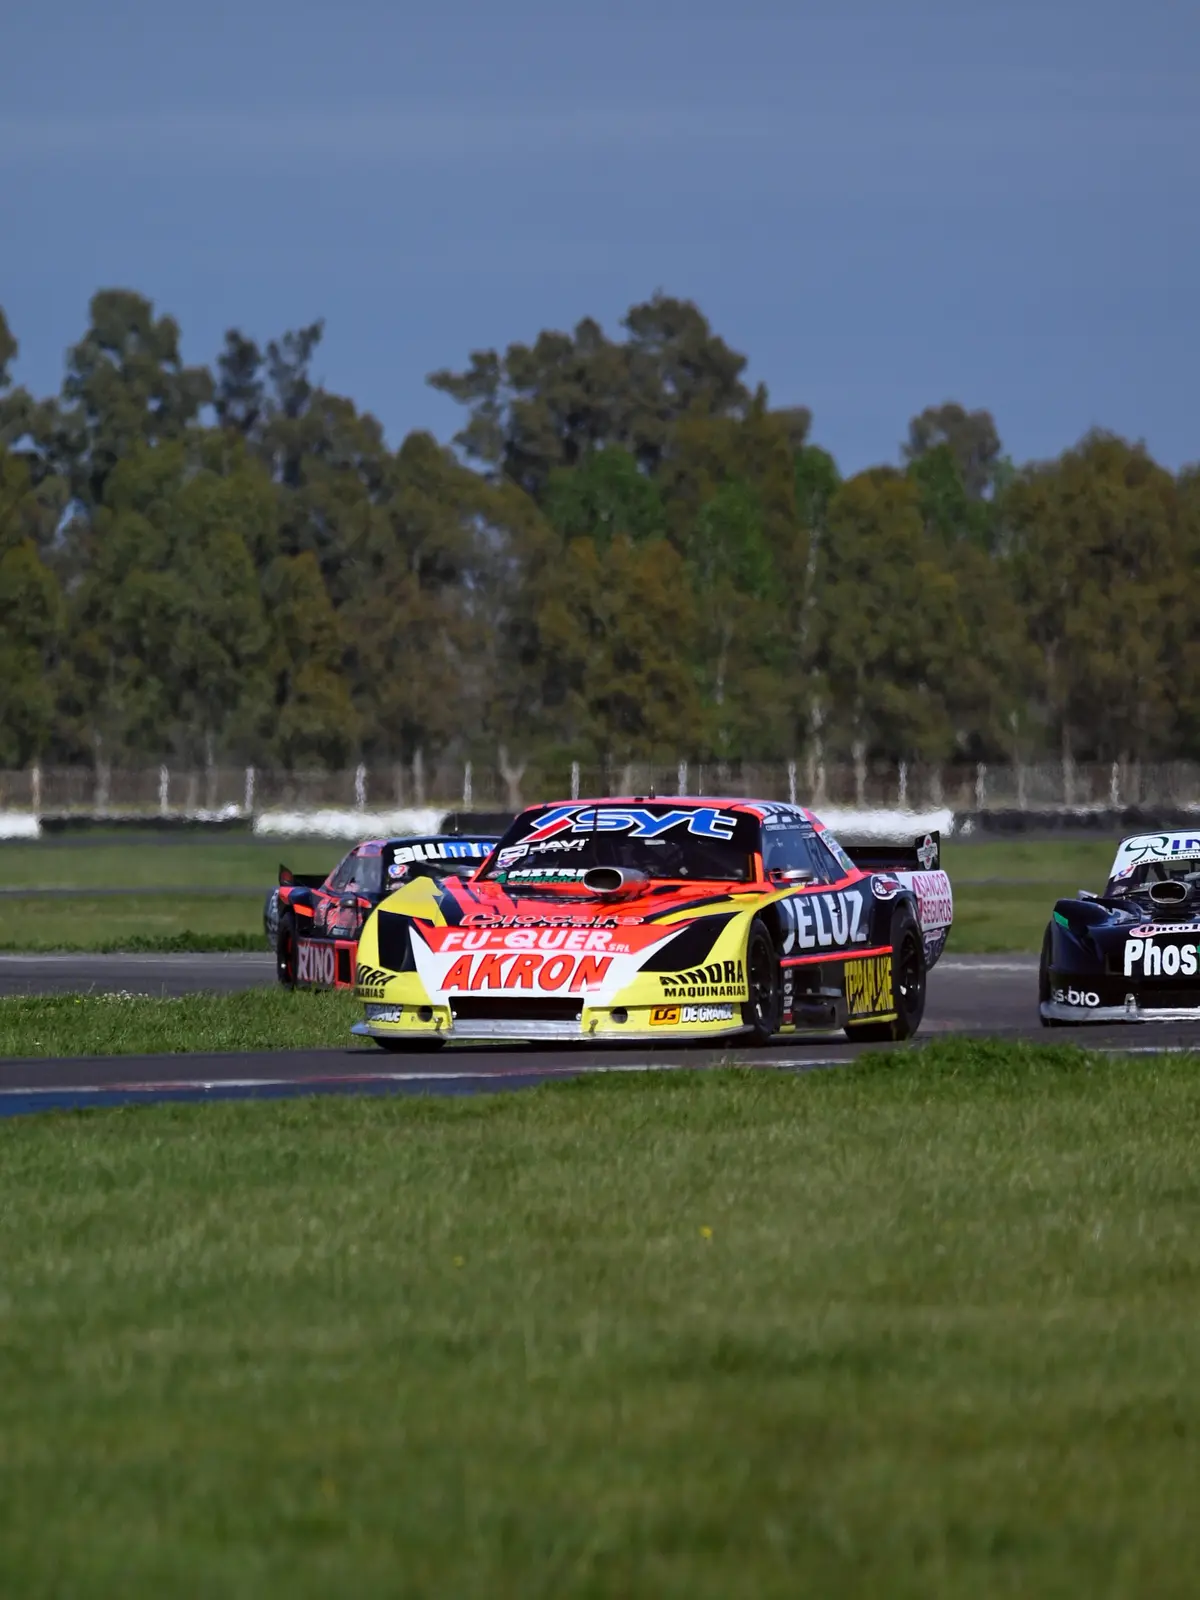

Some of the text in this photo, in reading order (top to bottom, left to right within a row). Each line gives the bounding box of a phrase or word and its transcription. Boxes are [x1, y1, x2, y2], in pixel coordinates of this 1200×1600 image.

[440, 929, 631, 953] FU-QUER SRL
[1124, 938, 1200, 977] Phos
[436, 954, 613, 993] AKRON
[664, 985, 746, 998] MAQUINARIAS
